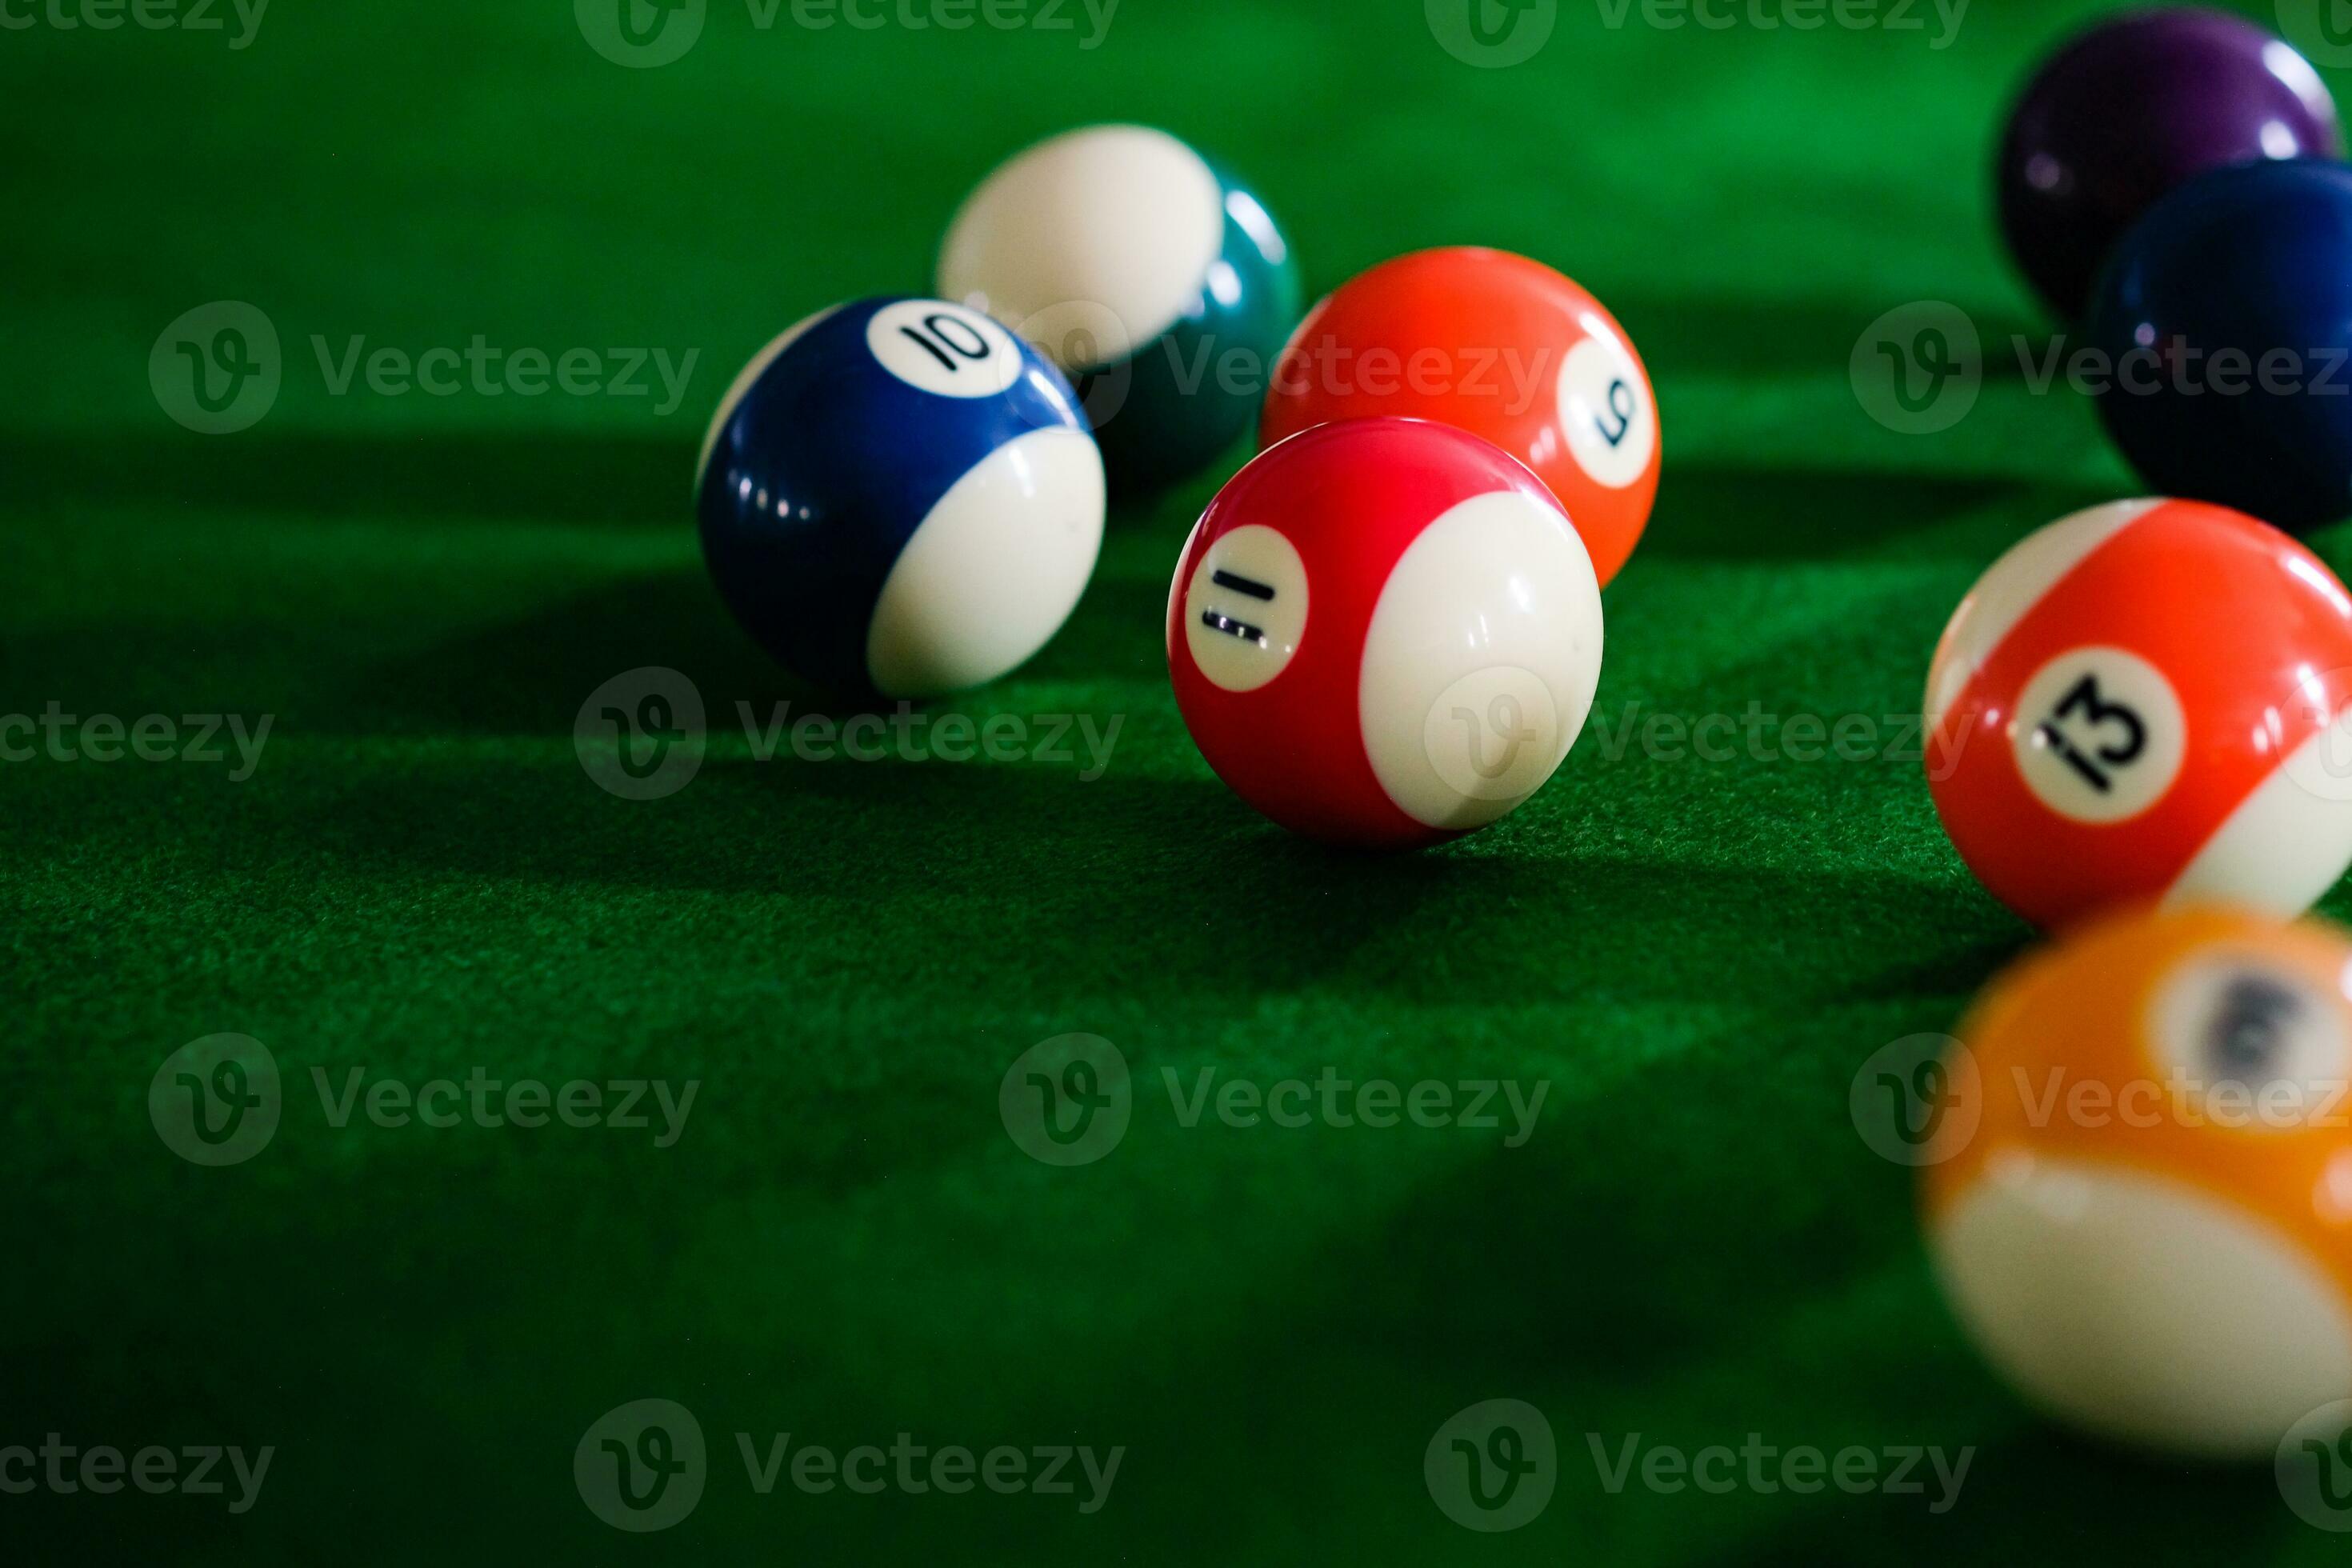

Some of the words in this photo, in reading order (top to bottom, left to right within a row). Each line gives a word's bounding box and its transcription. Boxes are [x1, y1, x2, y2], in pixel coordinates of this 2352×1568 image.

[899, 314, 990, 372] 10
[1202, 569, 1276, 646] 11
[2038, 673, 2148, 794] 13
